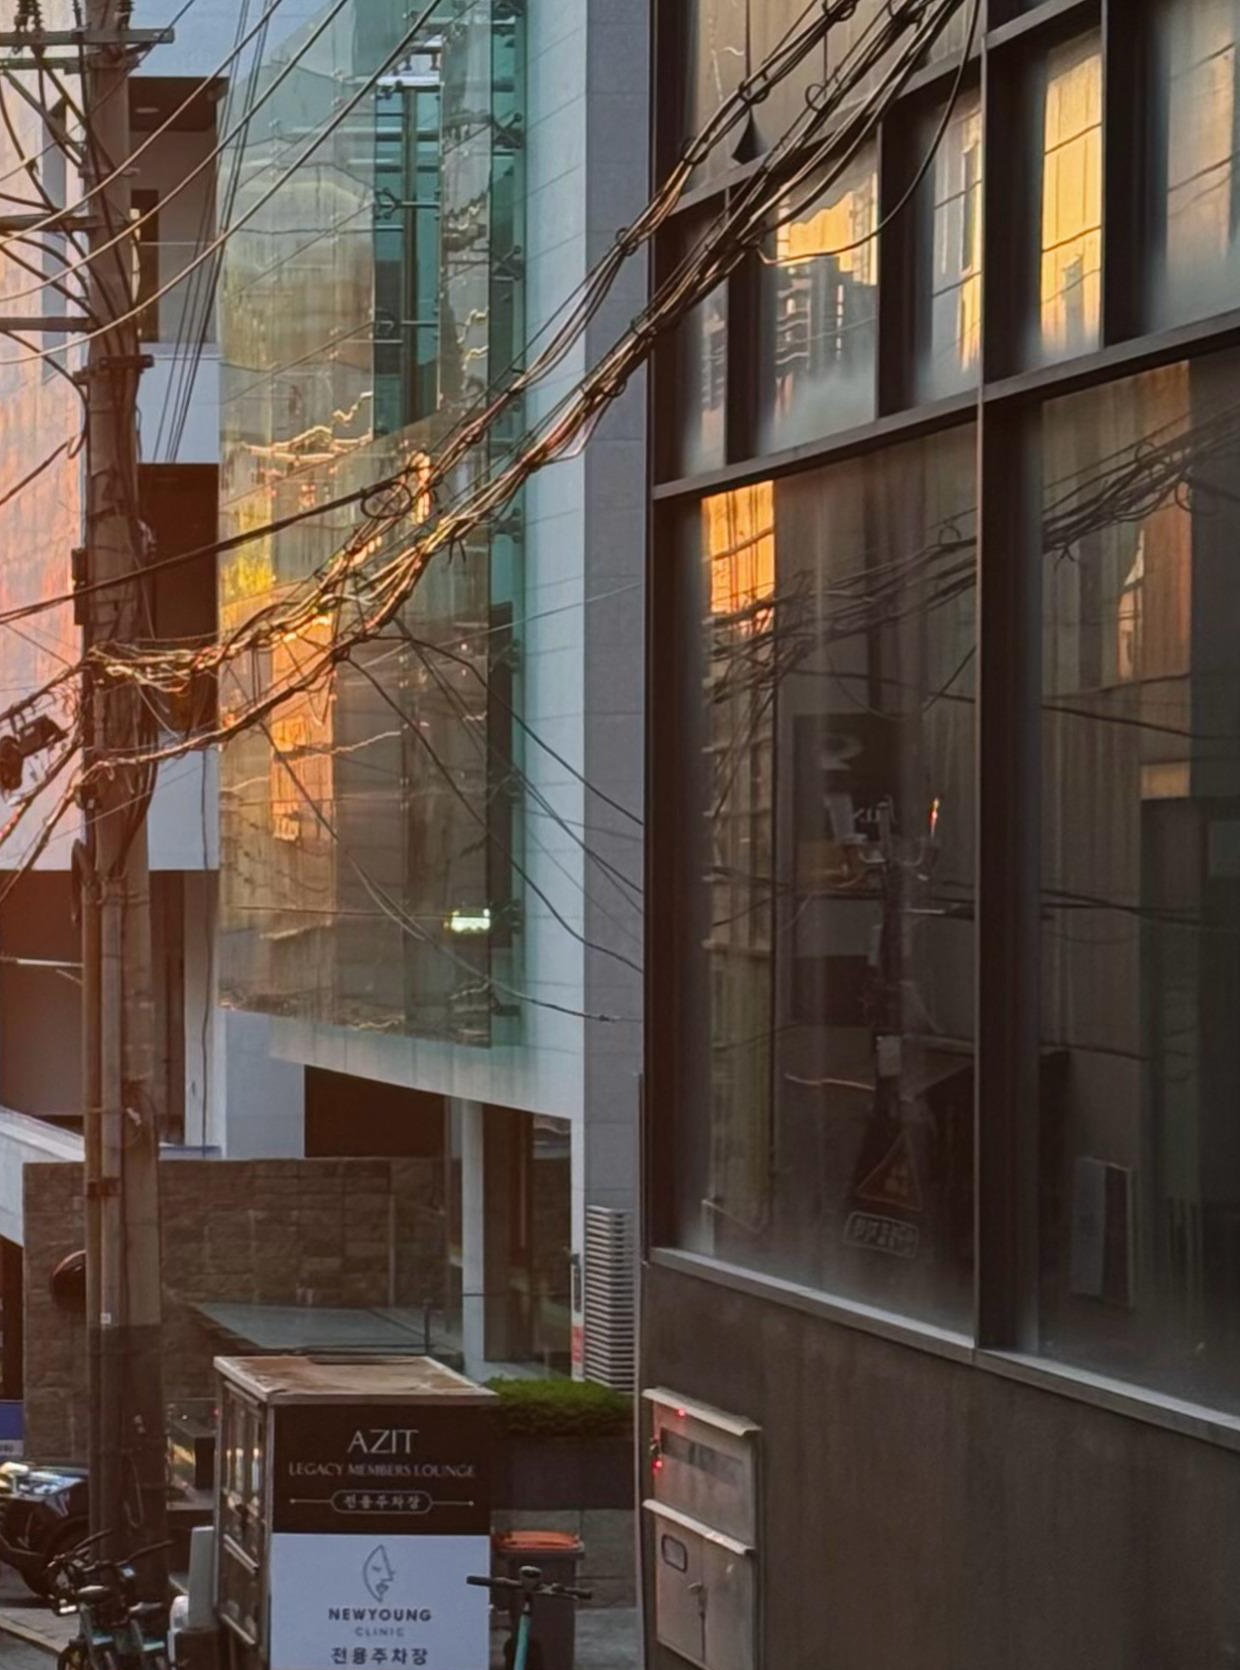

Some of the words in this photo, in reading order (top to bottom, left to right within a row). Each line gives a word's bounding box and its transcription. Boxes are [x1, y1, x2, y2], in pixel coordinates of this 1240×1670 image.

[347, 1429, 419, 1454] AZIT
[288, 1462, 343, 1477] LEGACY
[347, 1462, 410, 1477] MEMBERS
[413, 1463, 475, 1478] LOUNGE
[328, 1607, 432, 1622] NEWYOUNG
[354, 1627, 405, 1637] CLINIC
[331, 1647, 428, 1666] 전용주차장
